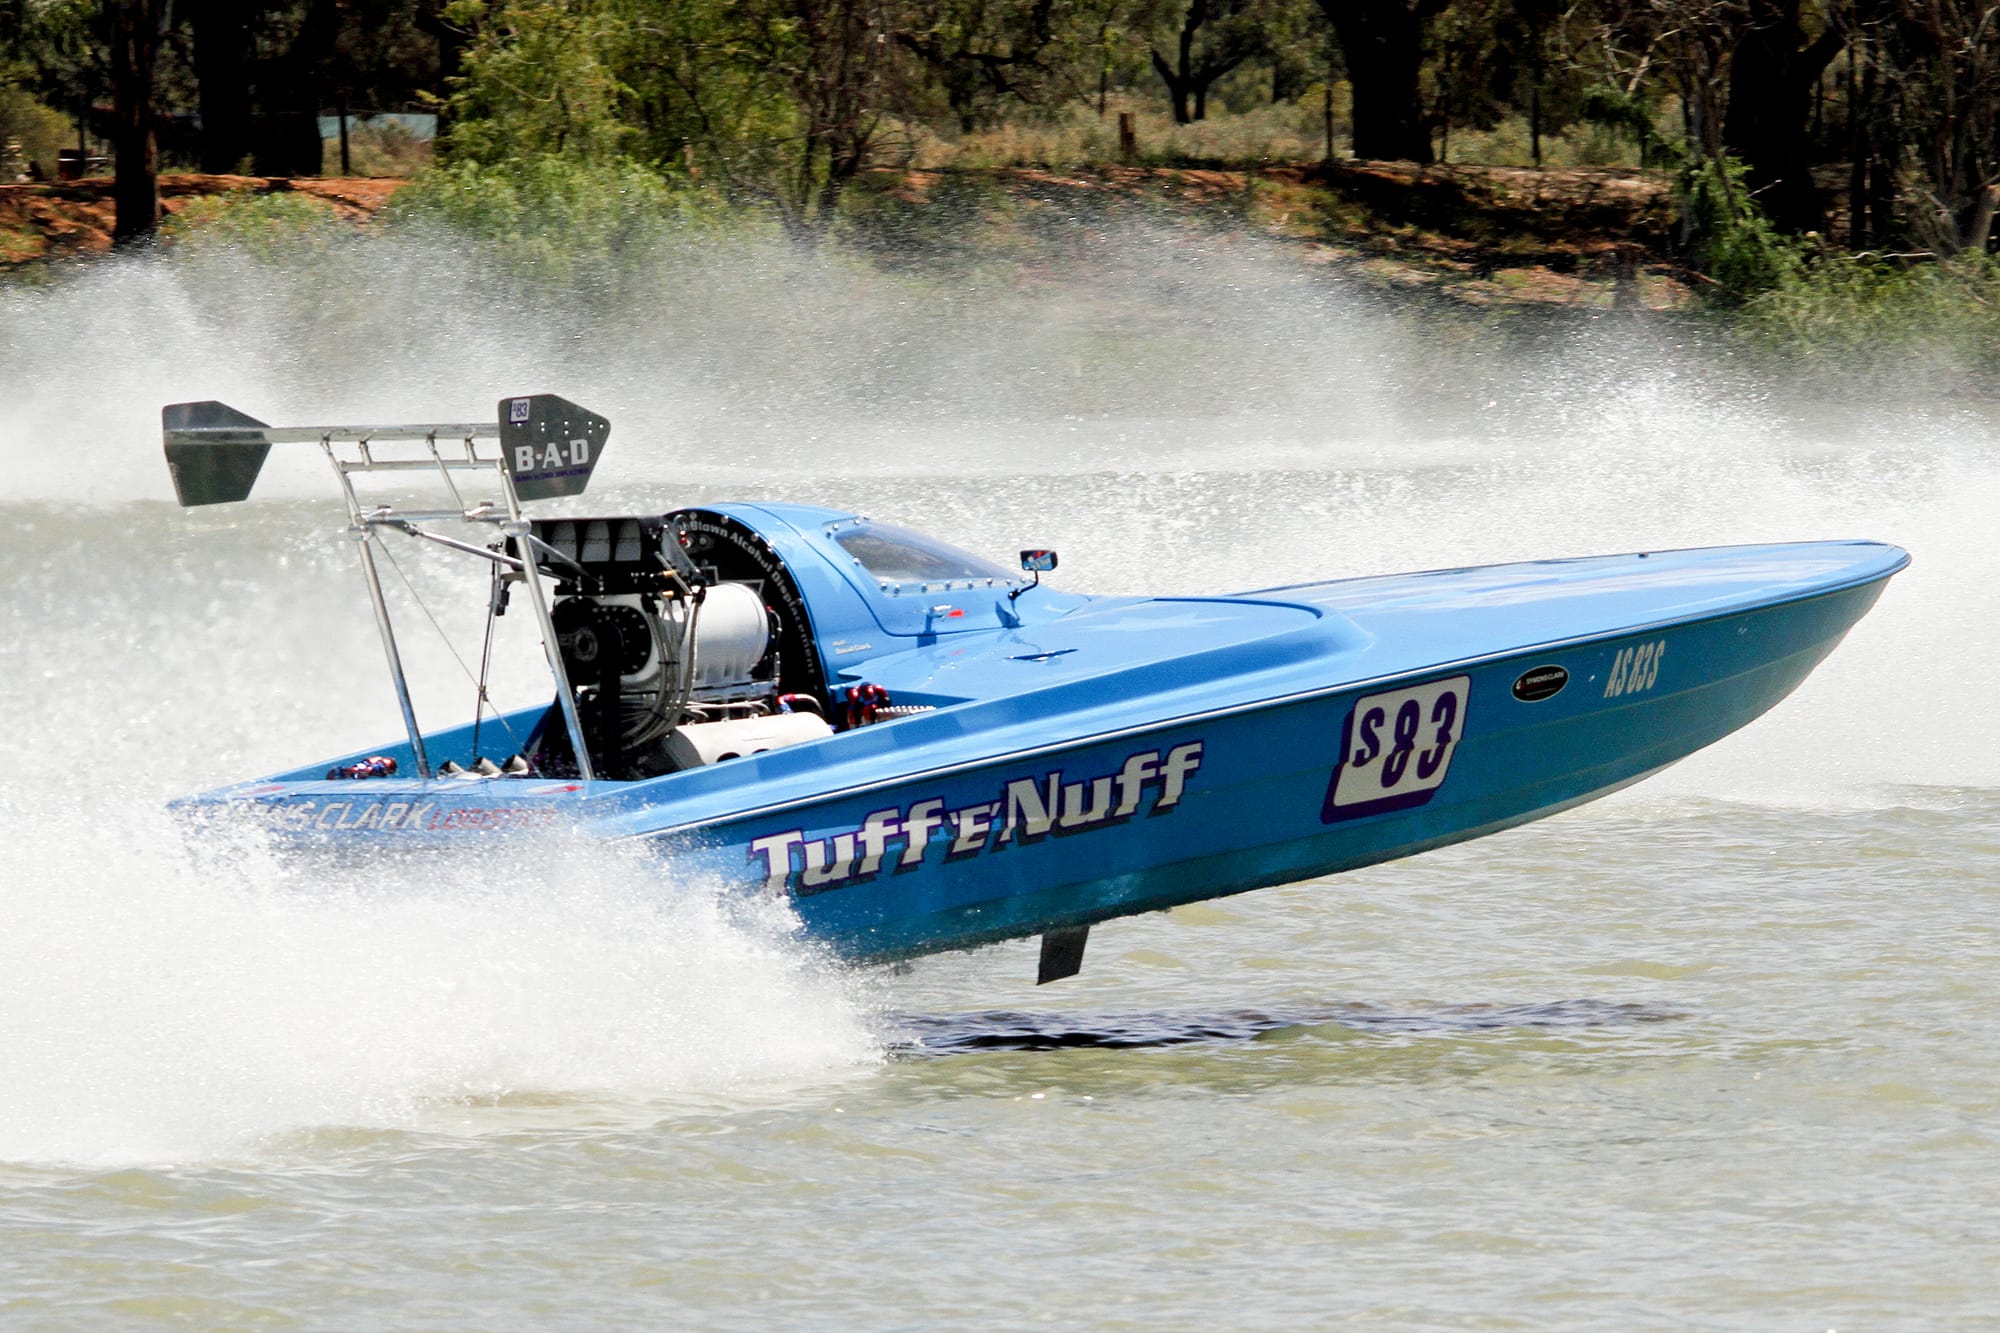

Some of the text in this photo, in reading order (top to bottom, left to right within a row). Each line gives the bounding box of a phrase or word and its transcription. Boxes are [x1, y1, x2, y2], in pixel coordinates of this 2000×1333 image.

[690, 520, 815, 674] Blown Alcohol Displacement
[1352, 690, 1457, 788] S83
[750, 797, 944, 894] Tuff
[999, 740, 1204, 842] Nuff
